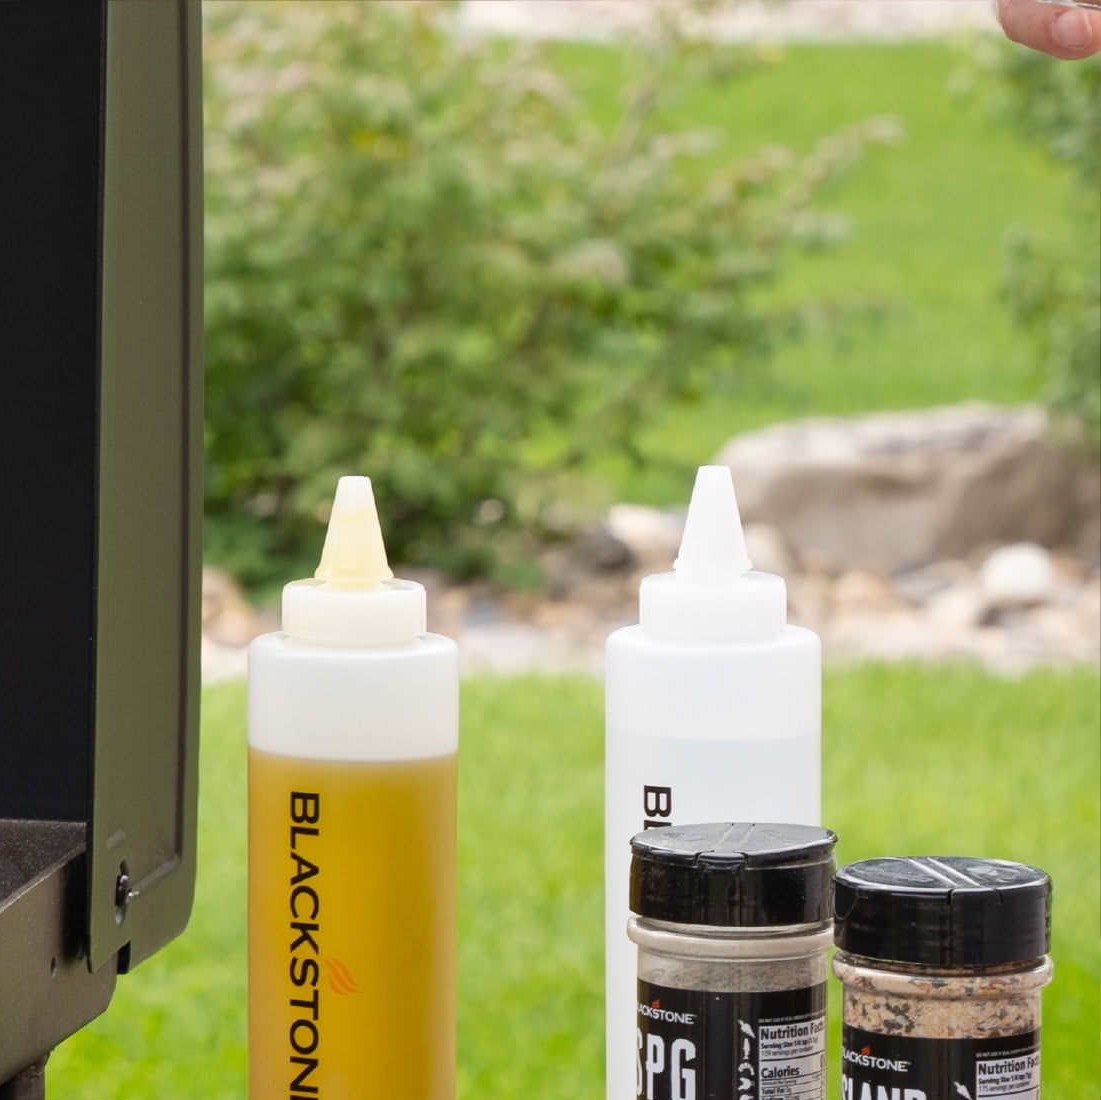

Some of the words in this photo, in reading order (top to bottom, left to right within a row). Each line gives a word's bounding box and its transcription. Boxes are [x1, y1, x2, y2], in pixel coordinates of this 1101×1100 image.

[760, 1025, 808, 1040] Nutrition
[761, 1065, 800, 1079] Calories
[978, 1059, 1026, 1075] Nutrition
